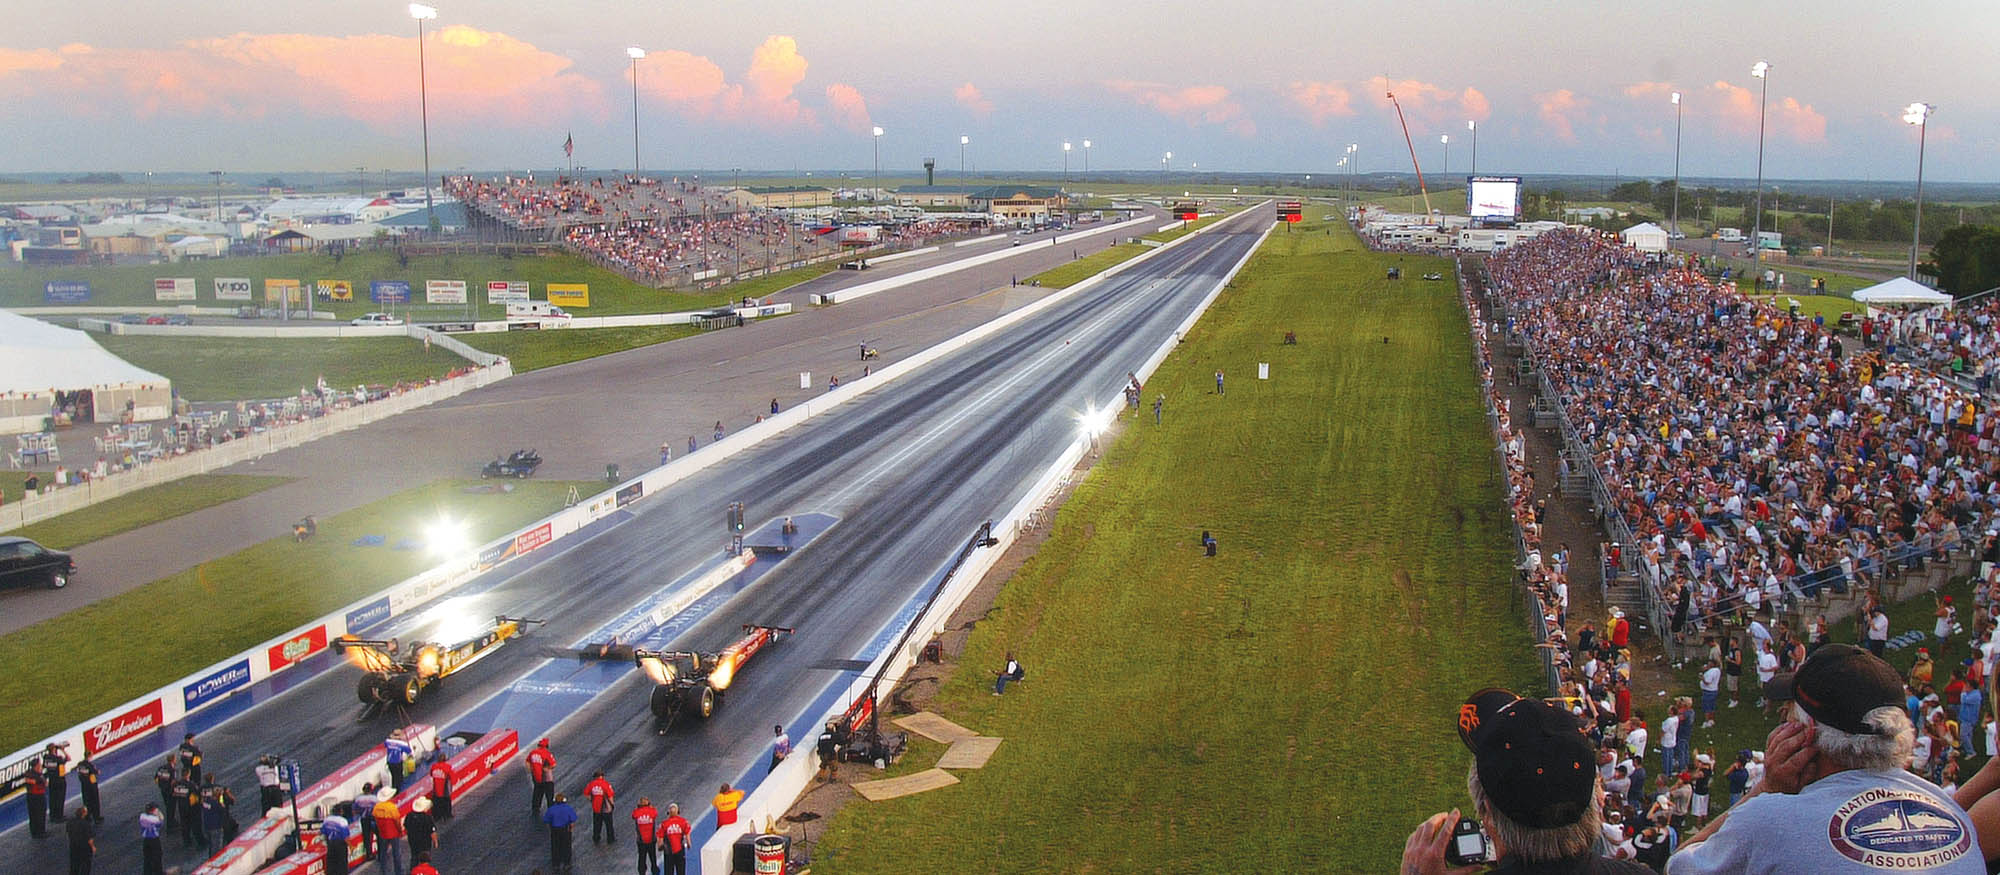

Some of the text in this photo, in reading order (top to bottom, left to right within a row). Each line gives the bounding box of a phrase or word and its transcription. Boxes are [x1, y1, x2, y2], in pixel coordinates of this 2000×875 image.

[93, 712, 153, 751] Budweiser
[484, 740, 517, 769] Budweiser
[1870, 834, 1913, 846] DEDICATED
[1913, 834, 1924, 842] TO
[1864, 846, 1962, 868] ASSOCIATION
